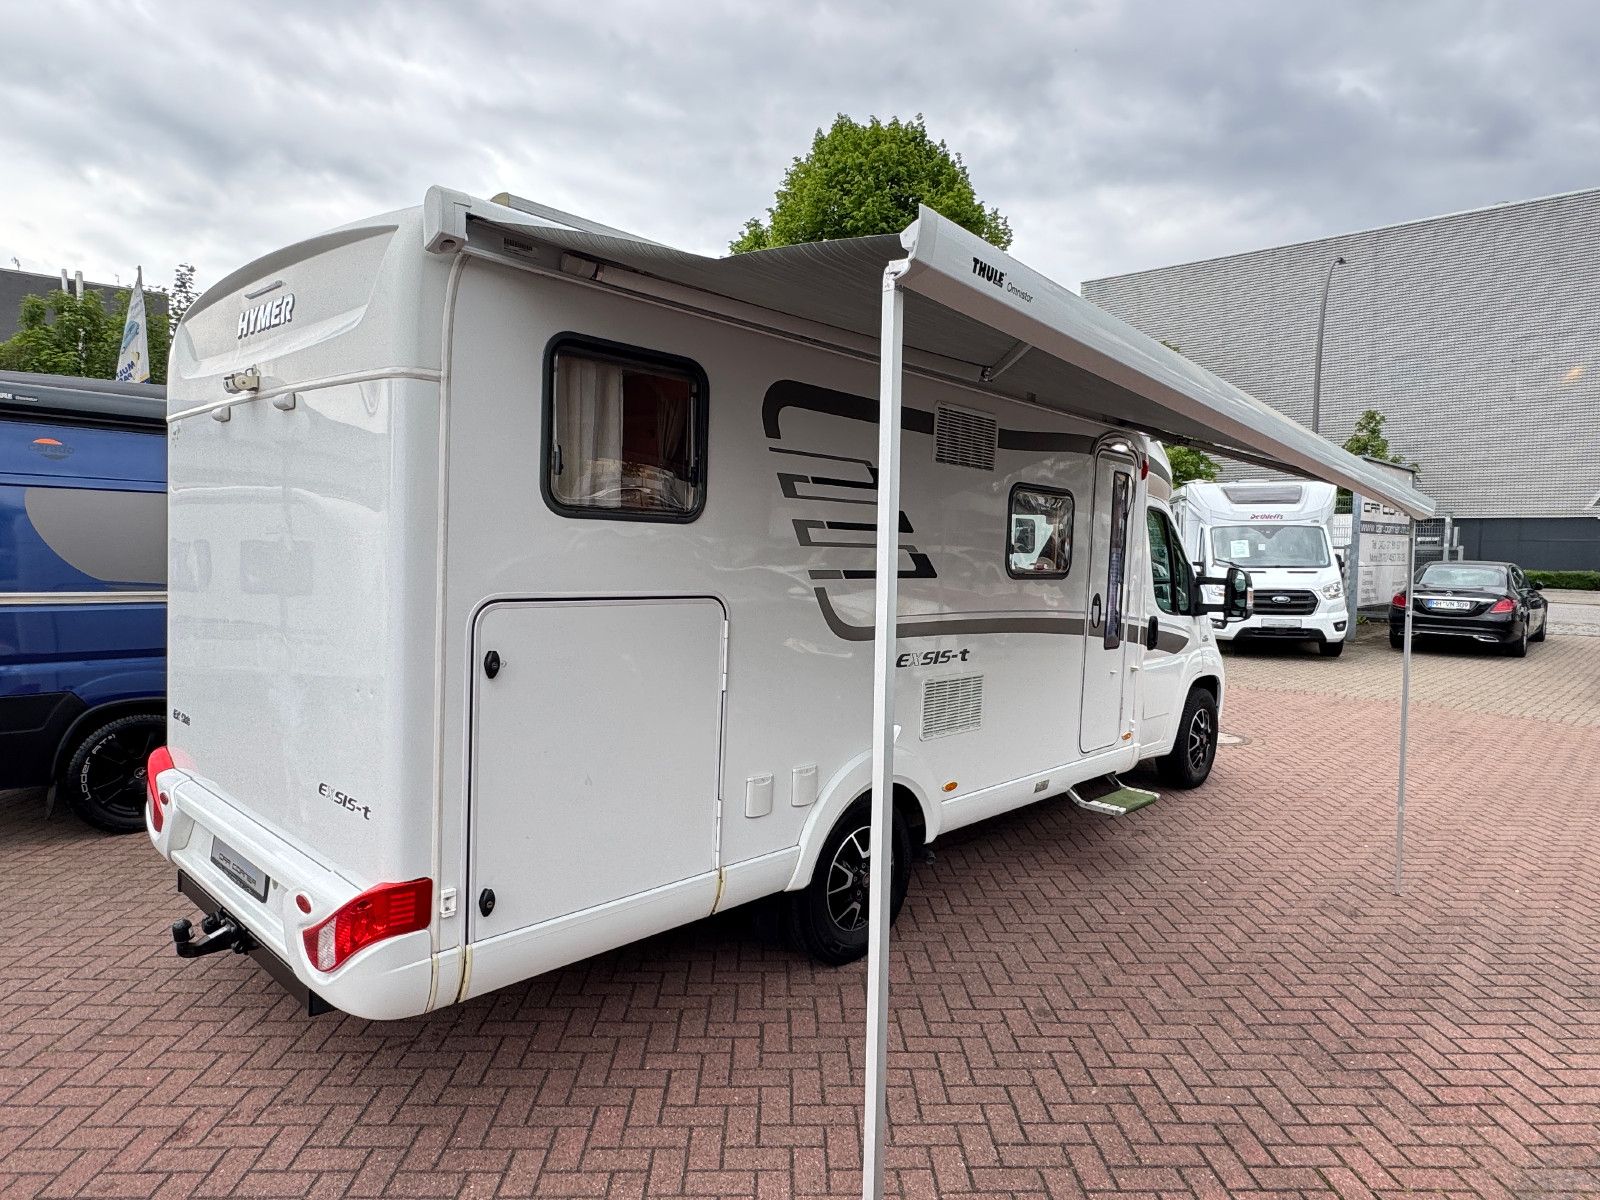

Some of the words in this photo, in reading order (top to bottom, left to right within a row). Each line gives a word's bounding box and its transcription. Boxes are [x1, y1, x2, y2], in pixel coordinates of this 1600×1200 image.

[972, 256, 1006, 289] THULE
[1007, 281, 1034, 303] Omnistor
[237, 292, 296, 340] HYMER
